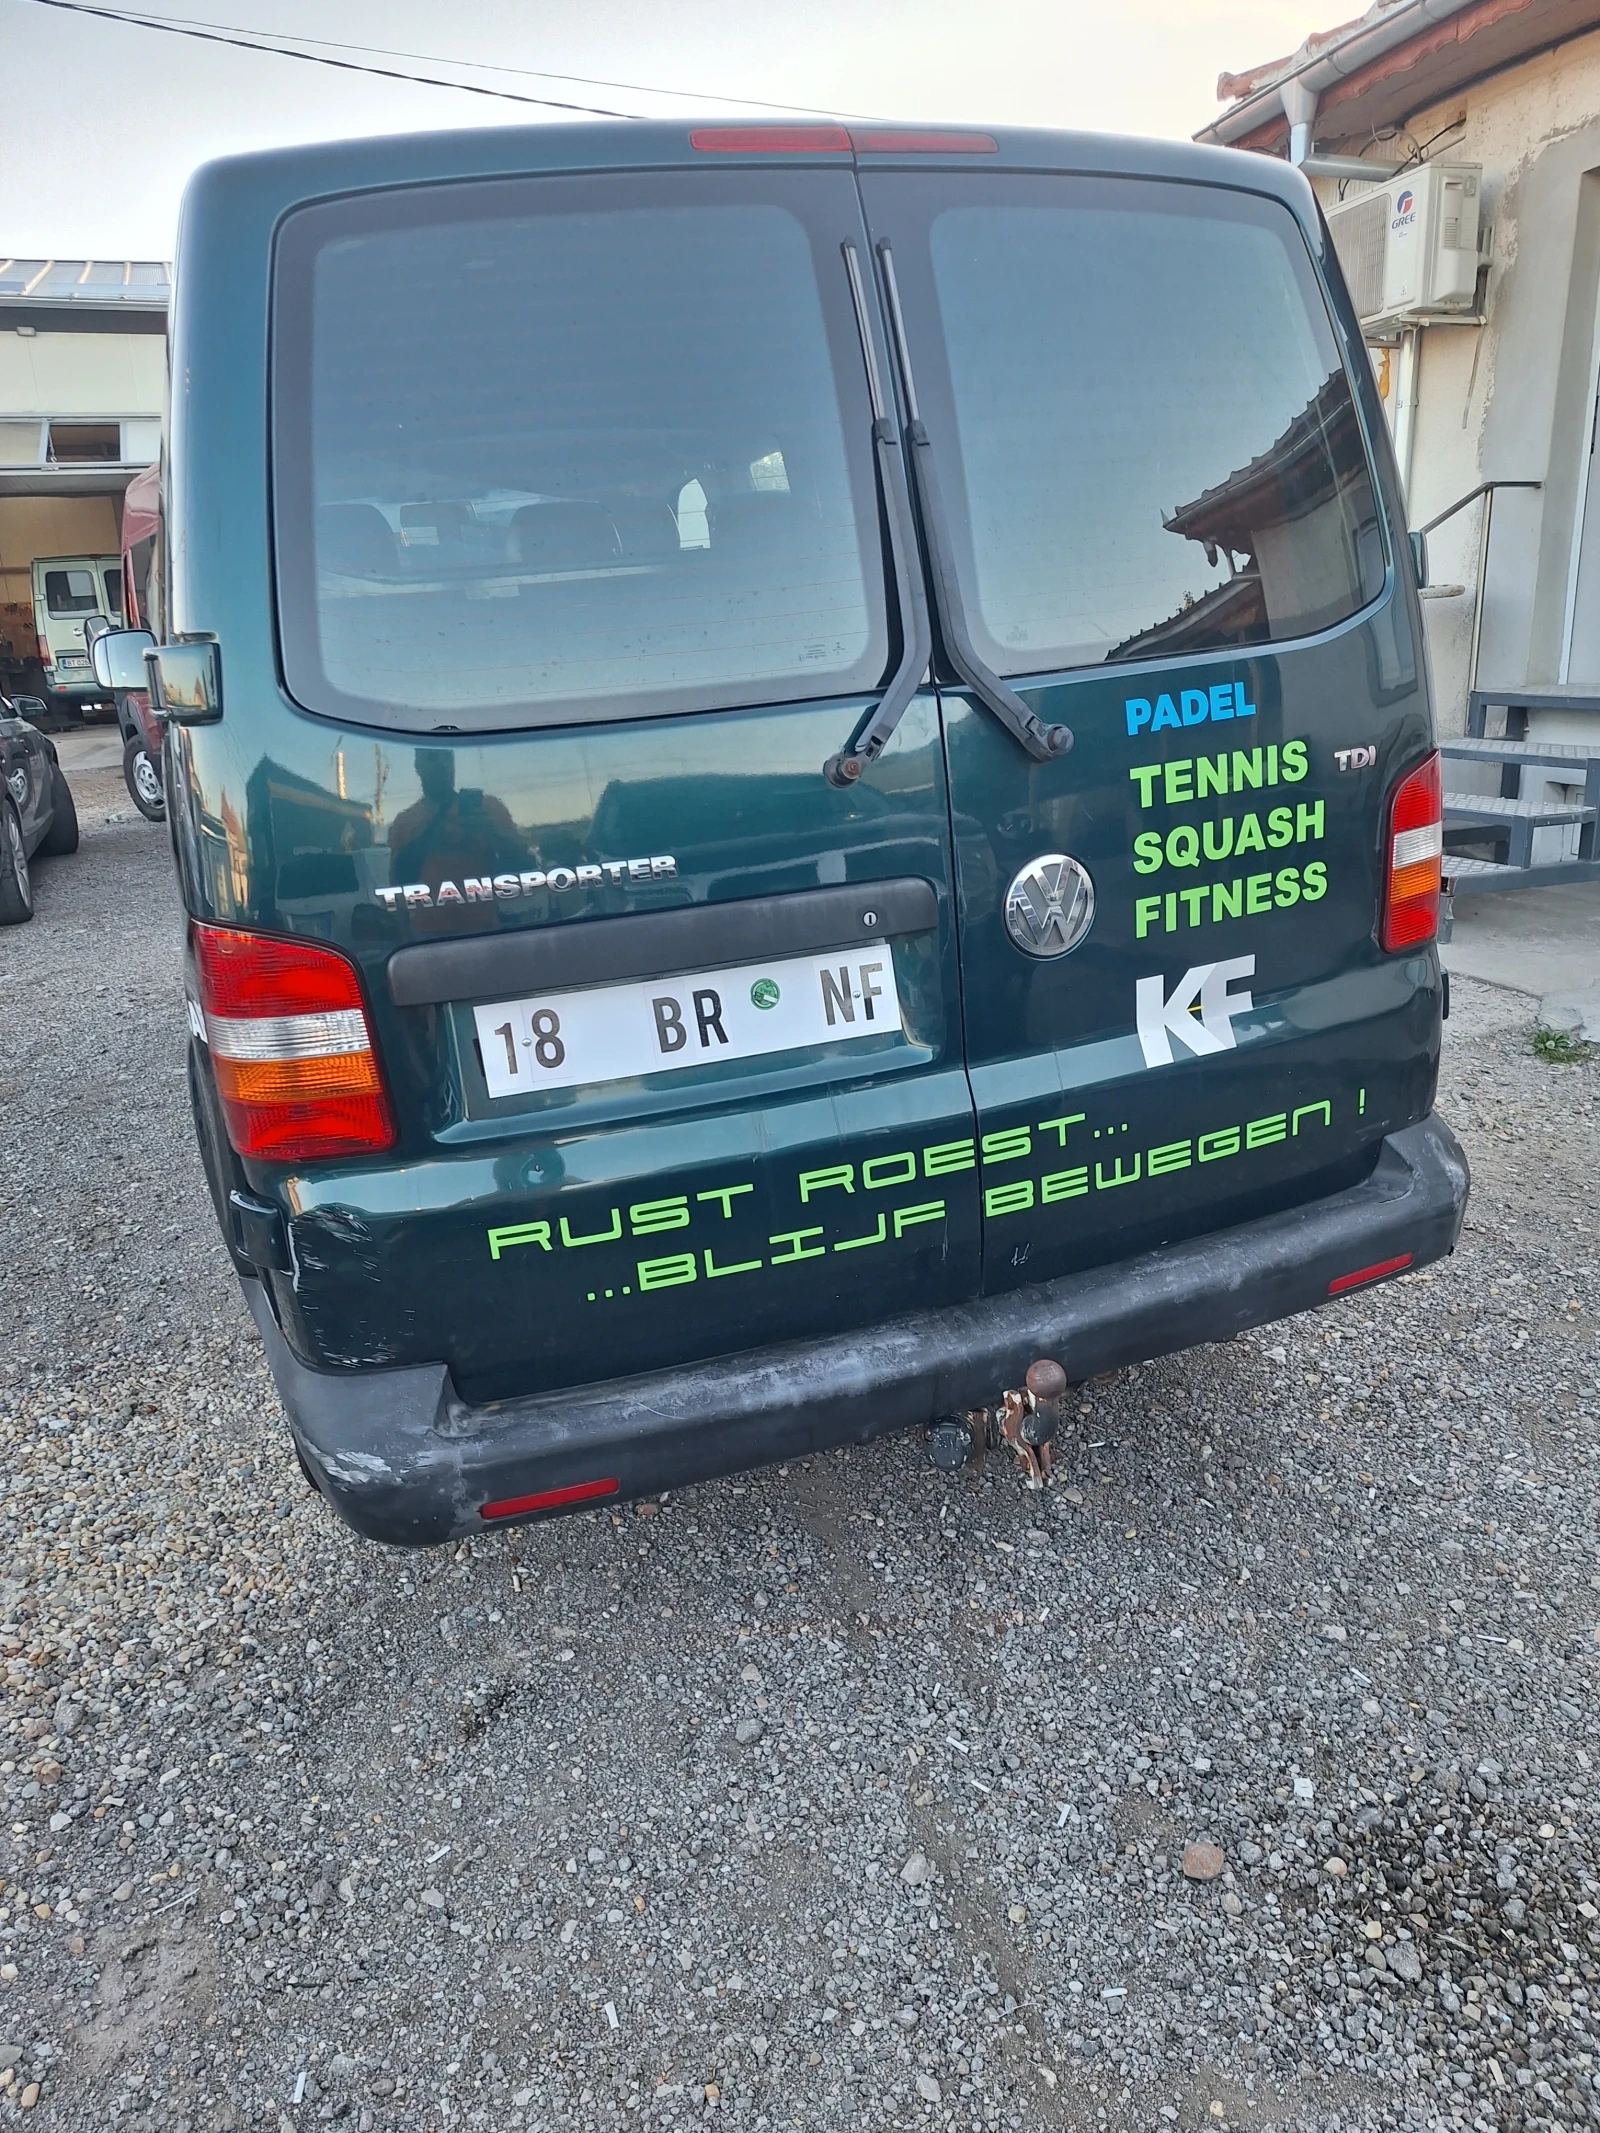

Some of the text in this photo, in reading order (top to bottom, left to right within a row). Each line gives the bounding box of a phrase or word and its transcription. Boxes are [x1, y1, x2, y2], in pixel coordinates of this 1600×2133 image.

[1391, 211, 1417, 230] GREE
[1125, 681, 1257, 736] PADEL
[1129, 740, 1309, 809] TENNIS
[1333, 745, 1377, 772] TDI
[1132, 799, 1326, 875] SQUASH
[374, 855, 679, 913] TRANSPORTER
[1135, 861, 1329, 939] FITNESS
[494, 962, 884, 1076] 18 BR NF
[1135, 953, 1257, 1069] KF
[984, 1099, 1331, 1218] BEWEGEN
[487, 1183, 754, 1260] RUST
